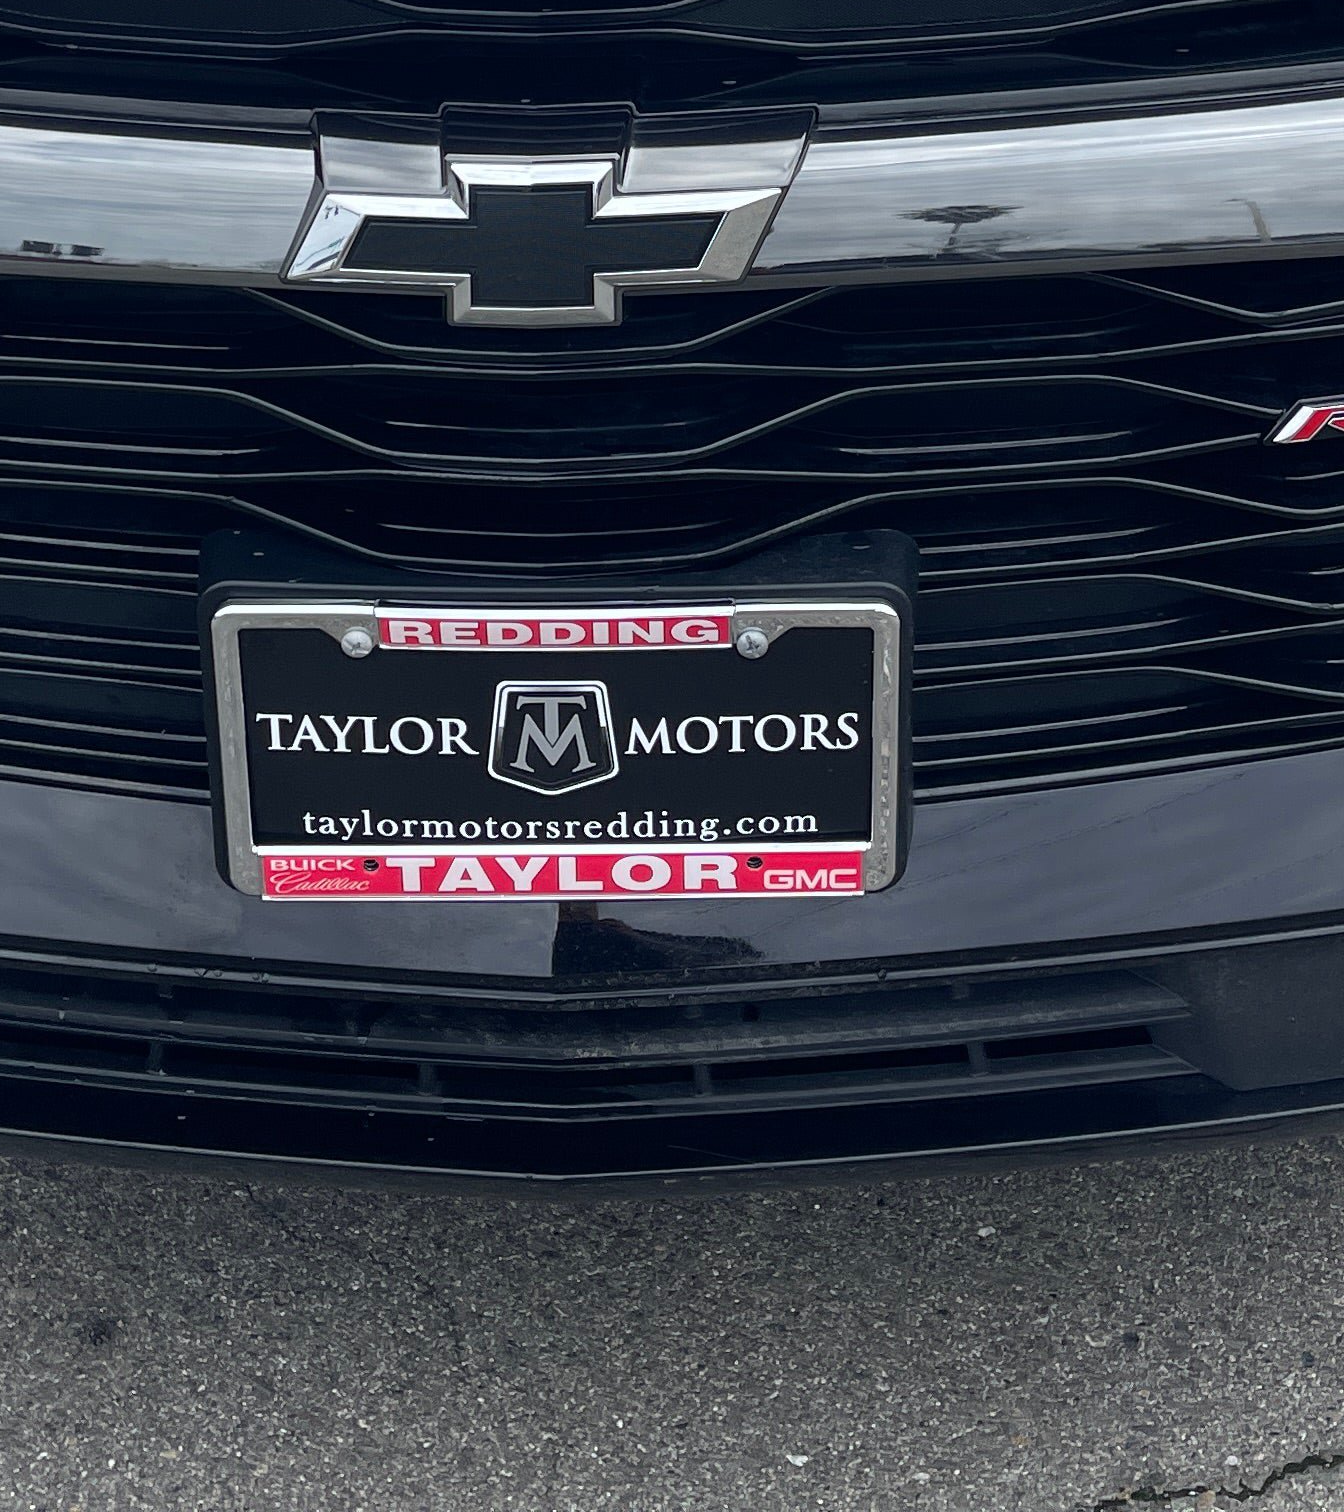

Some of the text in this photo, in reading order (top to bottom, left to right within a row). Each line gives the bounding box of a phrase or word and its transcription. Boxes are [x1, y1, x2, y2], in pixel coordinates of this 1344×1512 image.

[388, 619, 719, 646] REDDING
[255, 713, 480, 755] TAYLOR
[624, 712, 859, 754] MOTORS
[303, 809, 819, 841] taylormotorsredding.com
[269, 859, 355, 871] BUICK
[385, 855, 738, 892] TAYLOR
[763, 868, 857, 889] GMC
[269, 872, 370, 893] Cadillac
